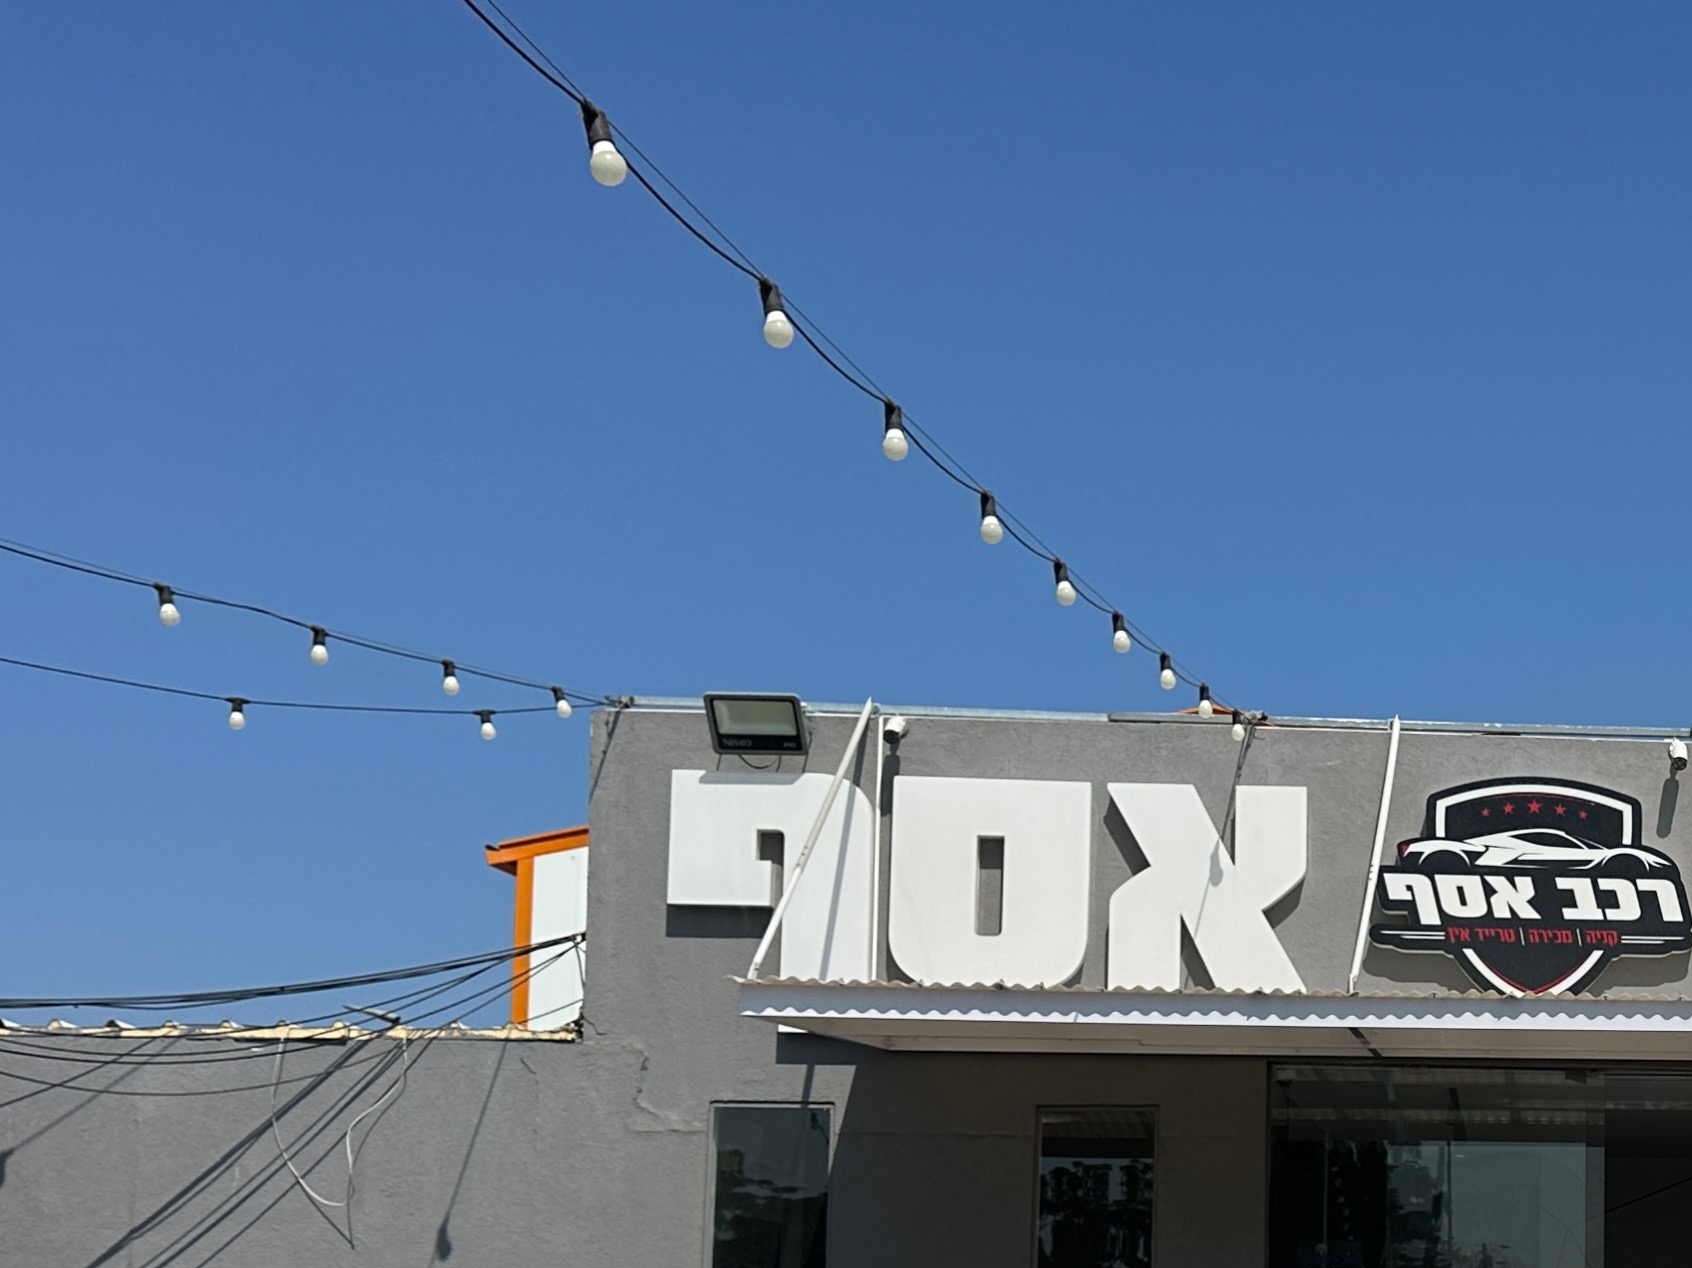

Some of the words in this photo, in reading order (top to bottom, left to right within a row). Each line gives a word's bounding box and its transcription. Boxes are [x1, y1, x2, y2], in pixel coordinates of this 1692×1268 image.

[666, 769, 1308, 992] אסף
[1382, 872, 1542, 926] אסף
[1554, 876, 1685, 923] רכב
[1447, 926, 1471, 944] אין
[1474, 927, 1516, 944] טרייד
[1528, 928, 1573, 944] מכירה
[1585, 929, 1618, 947] קניה
